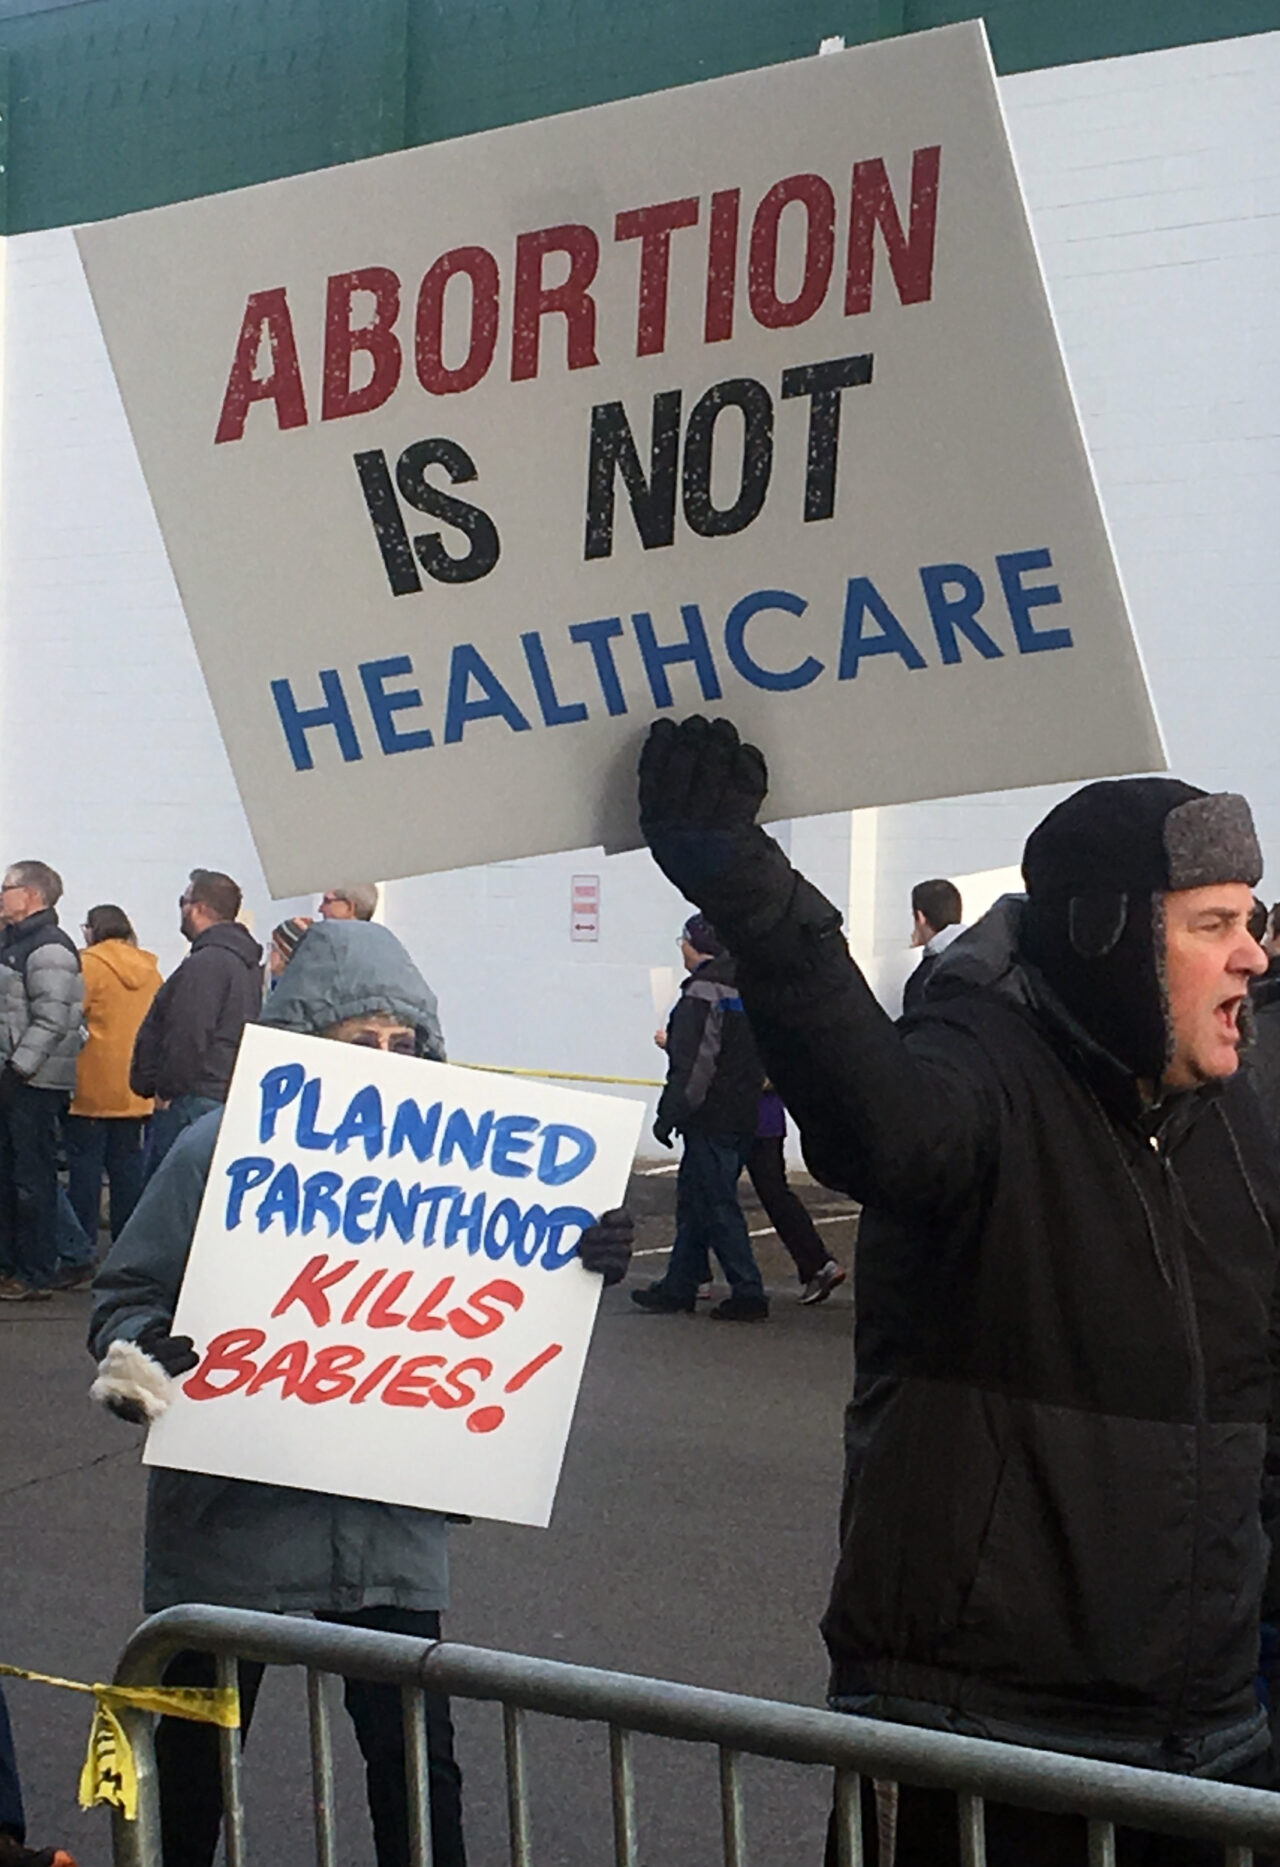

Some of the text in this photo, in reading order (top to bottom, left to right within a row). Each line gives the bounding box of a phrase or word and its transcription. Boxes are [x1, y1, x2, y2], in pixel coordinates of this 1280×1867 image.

[215, 146, 941, 444] ABORTION
[353, 353, 874, 597] IS NOT
[270, 548, 1072, 771] HEALTHCARE
[259, 1063, 596, 1185] PLANNED
[225, 1157, 598, 1270] PARENTHOOD
[271, 1254, 524, 1339] KILLS
[182, 1328, 563, 1433] BABIES!
